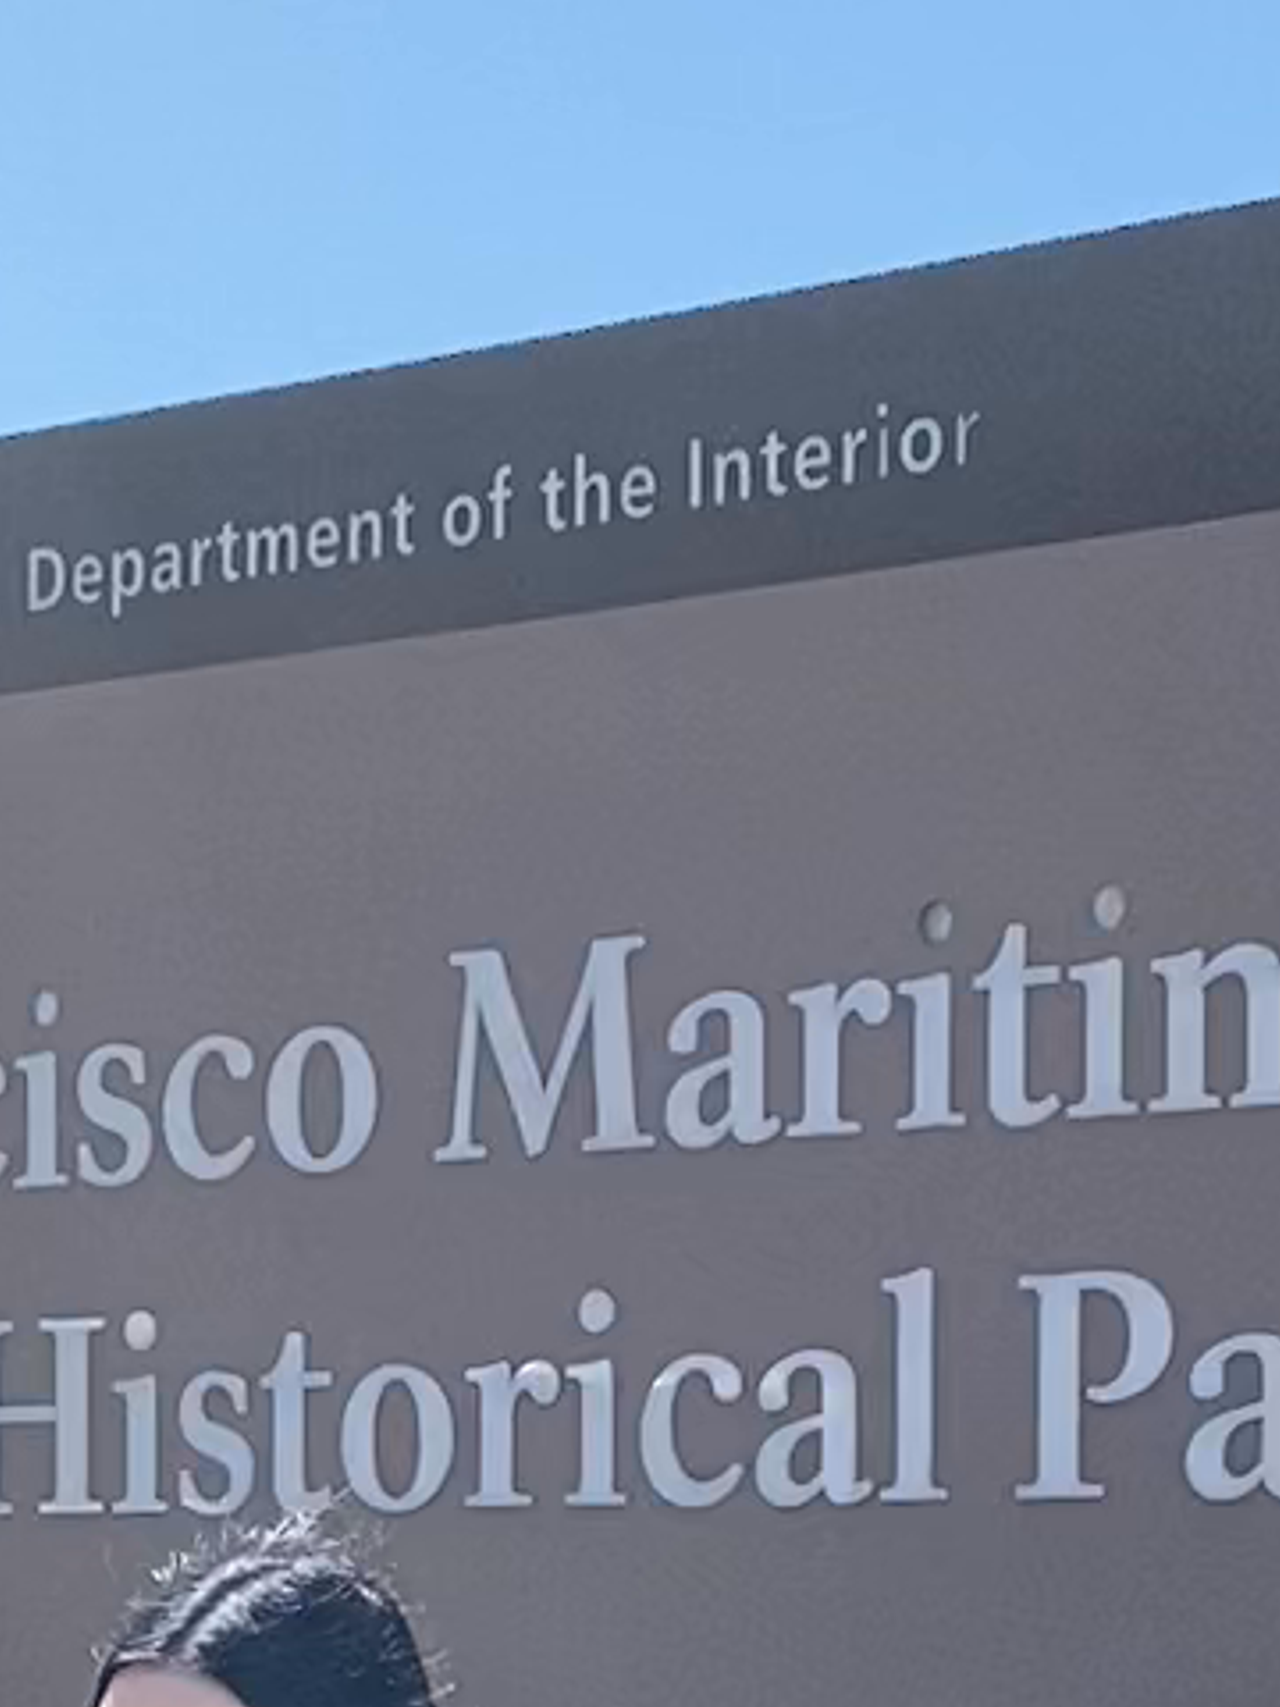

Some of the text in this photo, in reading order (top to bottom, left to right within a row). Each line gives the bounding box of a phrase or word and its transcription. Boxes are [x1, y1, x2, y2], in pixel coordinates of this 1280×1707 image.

[27, 493, 415, 618] Department
[442, 464, 513, 547] of
[539, 452, 656, 532] the
[689, 402, 980, 501] Interior
